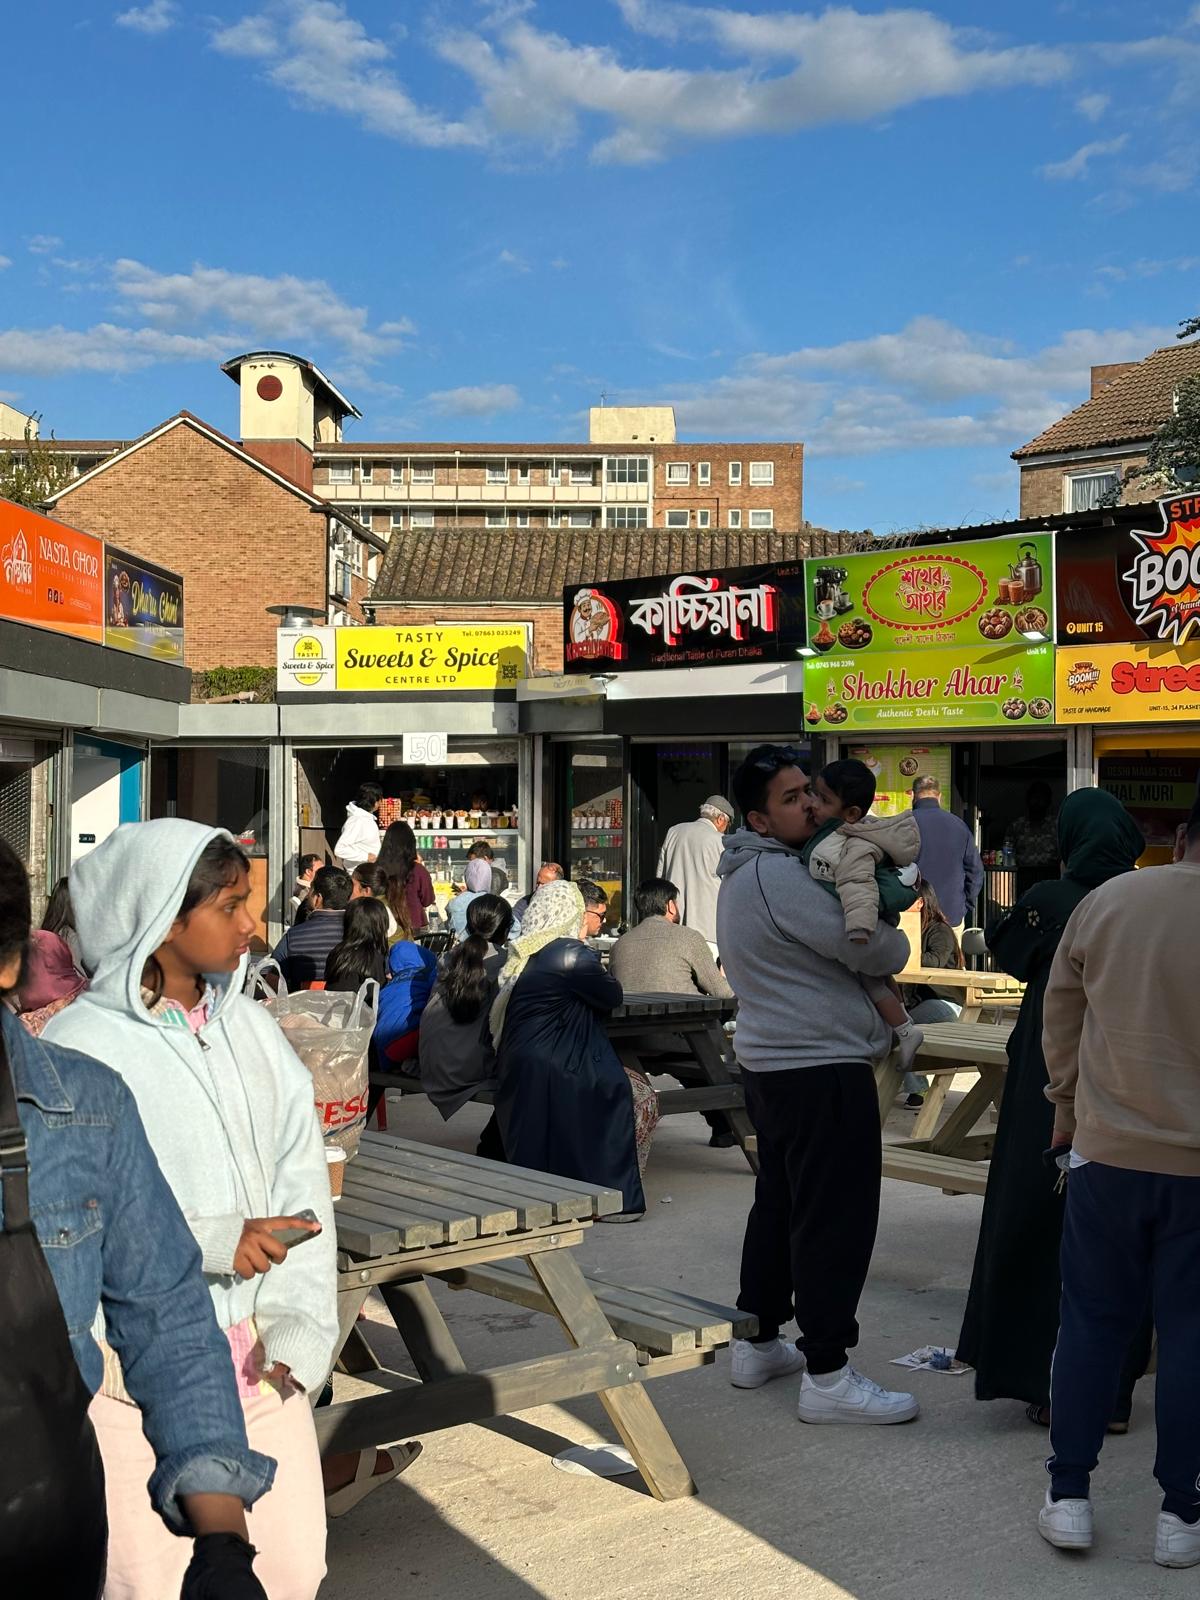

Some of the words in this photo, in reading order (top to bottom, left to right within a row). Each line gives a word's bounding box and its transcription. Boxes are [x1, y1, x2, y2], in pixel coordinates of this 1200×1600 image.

[39, 535, 71, 569] NASTA
[72, 549, 99, 578] GHOR
[1076, 622, 1094, 633] UNIT
[1094, 621, 1104, 633] 15
[395, 632, 444, 643] TASTY
[282, 661, 307, 670] Sweets
[315, 661, 335, 671] Spice
[344, 647, 414, 669] Sweets
[419, 647, 438, 668] &
[444, 646, 501, 673] Spice
[385, 675, 431, 684] CENTRE
[435, 674, 457, 683] LTD
[841, 667, 939, 701] Shokher
[943, 664, 1008, 697] Ahar
[876, 706, 914, 718] Authentic
[915, 705, 940, 717] Deshi
[941, 704, 964, 716] Taste
[1139, 784, 1174, 801] MURI
